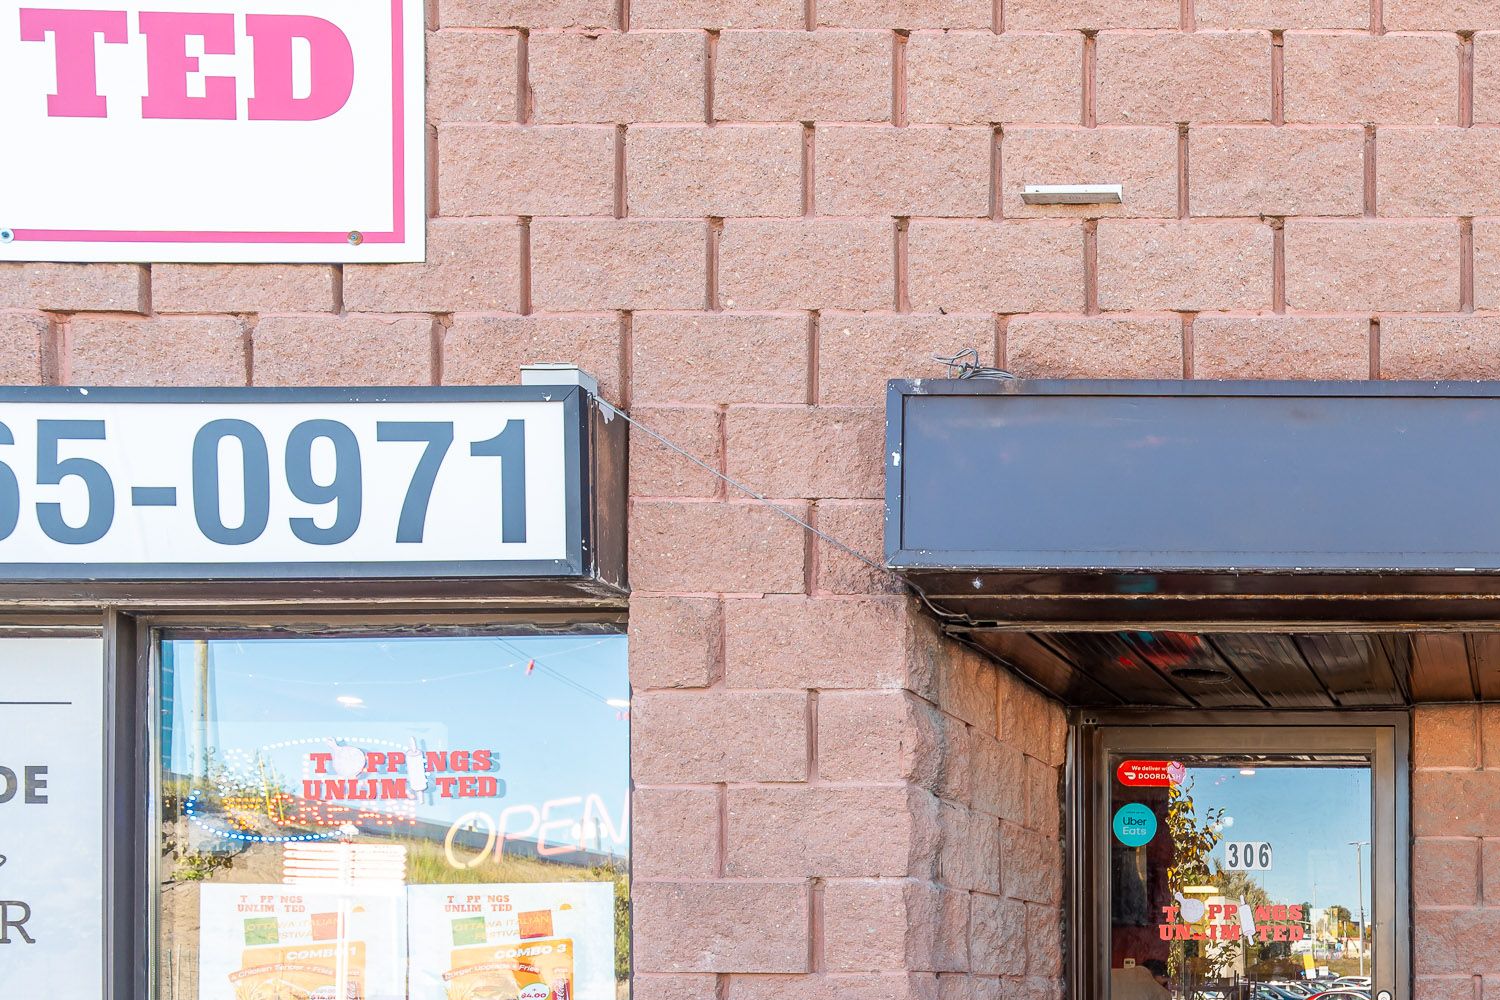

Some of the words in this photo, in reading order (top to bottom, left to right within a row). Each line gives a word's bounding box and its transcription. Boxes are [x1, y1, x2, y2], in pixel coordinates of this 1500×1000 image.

[0, 418, 527, 546] 5-0971
[1122, 816, 1147, 826] Uber
[1122, 826, 1147, 836] Eats
[444, 793, 629, 870] OPEN
[1228, 843, 1269, 868] 306
[494, 944, 552, 959] COMBO
